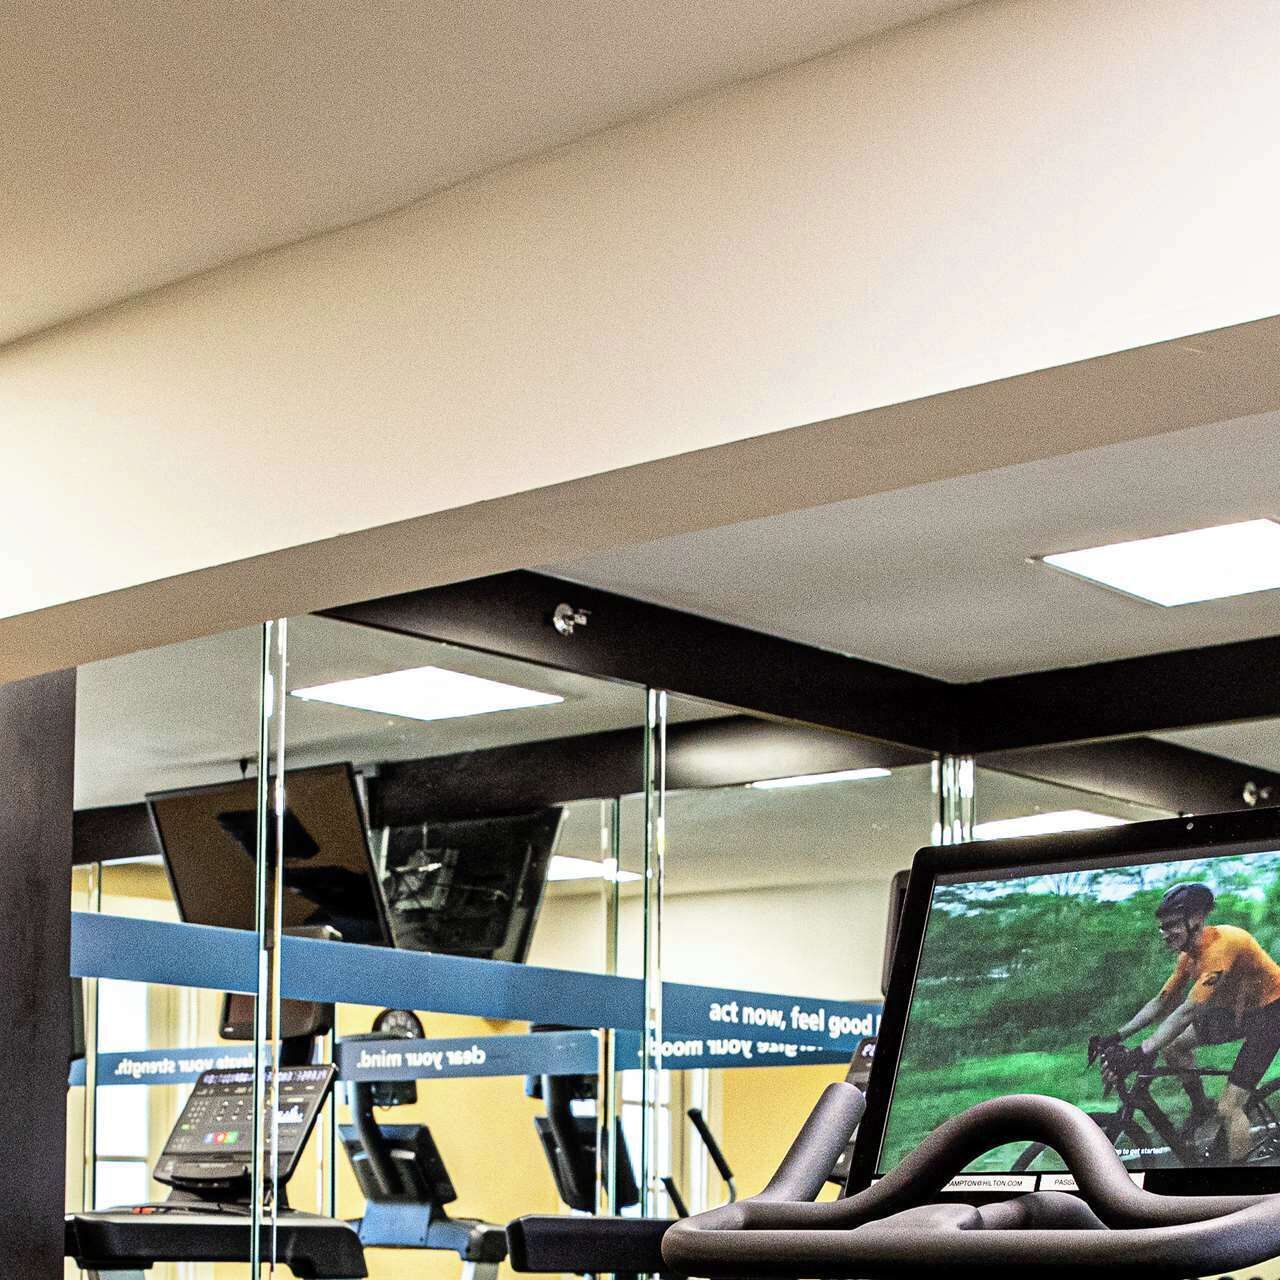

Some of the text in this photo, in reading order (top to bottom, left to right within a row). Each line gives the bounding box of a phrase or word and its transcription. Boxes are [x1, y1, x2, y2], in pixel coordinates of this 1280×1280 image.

[709, 1001, 738, 1023] act
[742, 1007, 787, 1030] now,
[790, 1005, 825, 1032] feel
[828, 1013, 873, 1038] good
